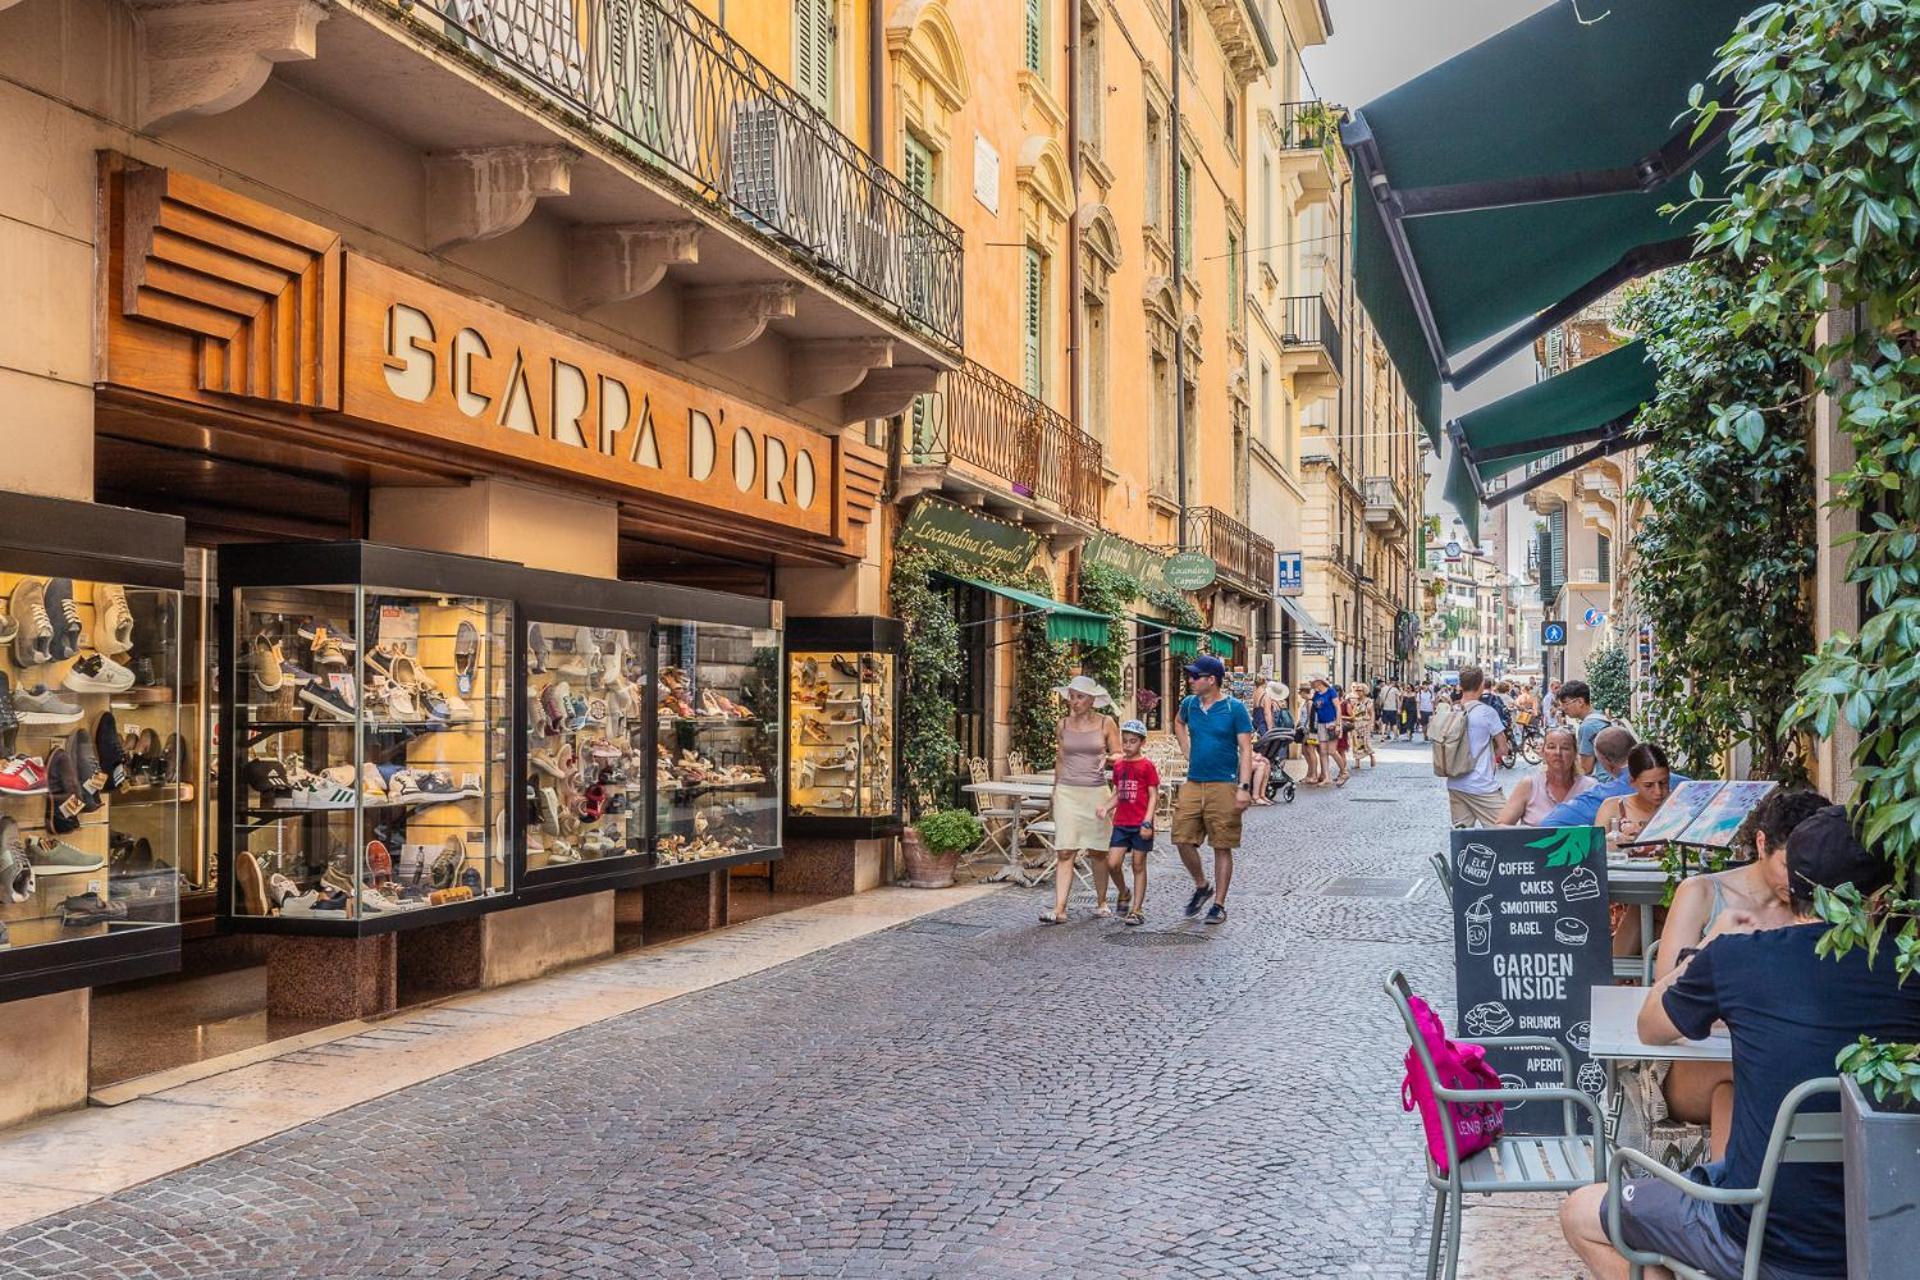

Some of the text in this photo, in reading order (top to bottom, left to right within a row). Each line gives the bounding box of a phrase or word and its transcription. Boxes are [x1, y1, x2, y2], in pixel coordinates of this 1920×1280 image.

[383, 302, 817, 511] SCARPA D'ORO
[914, 520, 1023, 566] Locandina Cappello
[1498, 861, 1535, 875] COFFEE
[1520, 881, 1554, 895] CAKES
[1500, 900, 1558, 914] SMOOTHIES
[1509, 922, 1543, 935] BAGEL
[1493, 953, 1574, 977] GARDEN
[1500, 976, 1568, 1000] INSIDE
[1519, 1016, 1561, 1029] BRUNCH
[1526, 1058, 1563, 1072] APERIT
